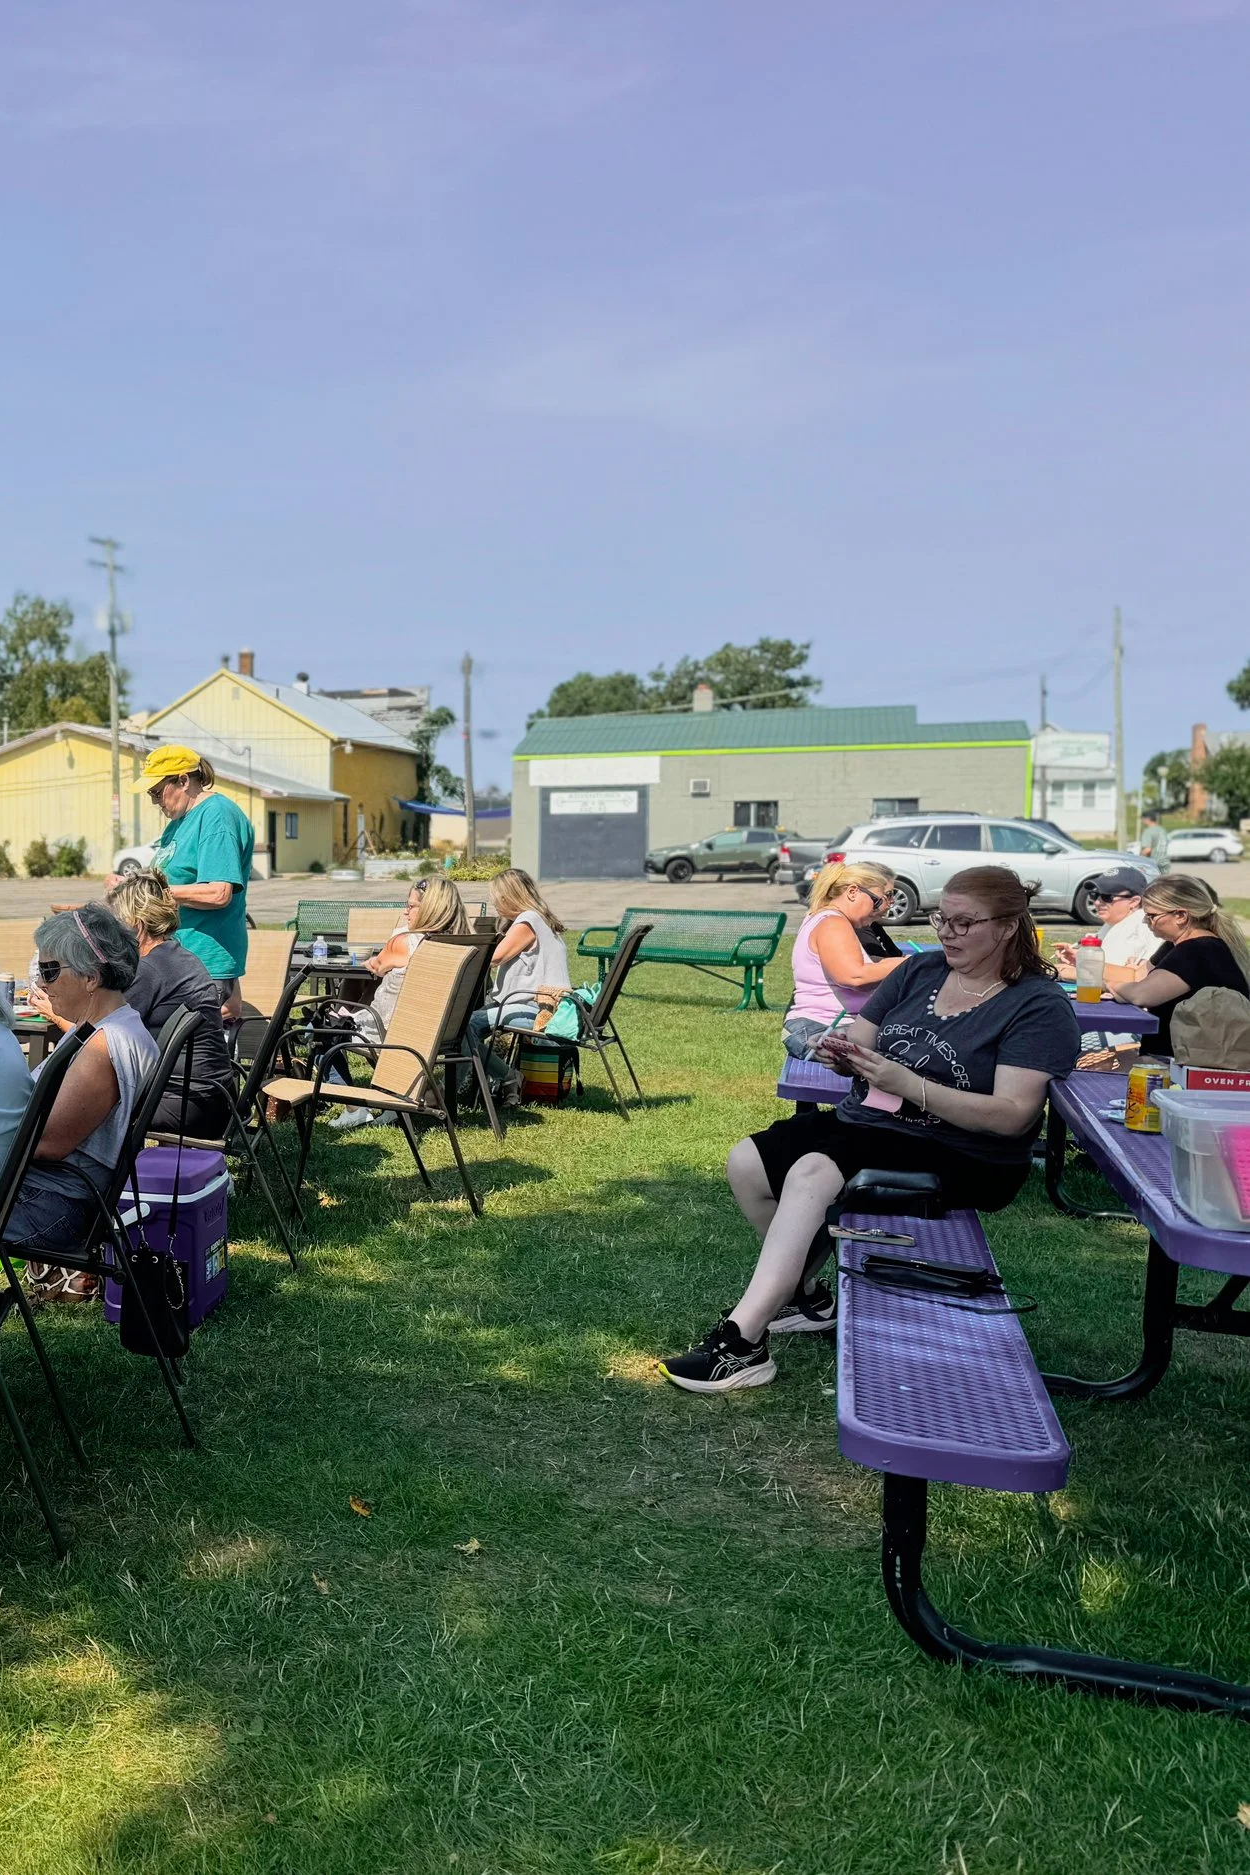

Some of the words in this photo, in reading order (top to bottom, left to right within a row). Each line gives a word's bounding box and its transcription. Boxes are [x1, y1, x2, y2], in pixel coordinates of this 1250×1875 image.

[883, 1024, 922, 1038] GREAT
[924, 1029, 957, 1062] TIMES
[1204, 1077, 1234, 1085] OVEN
